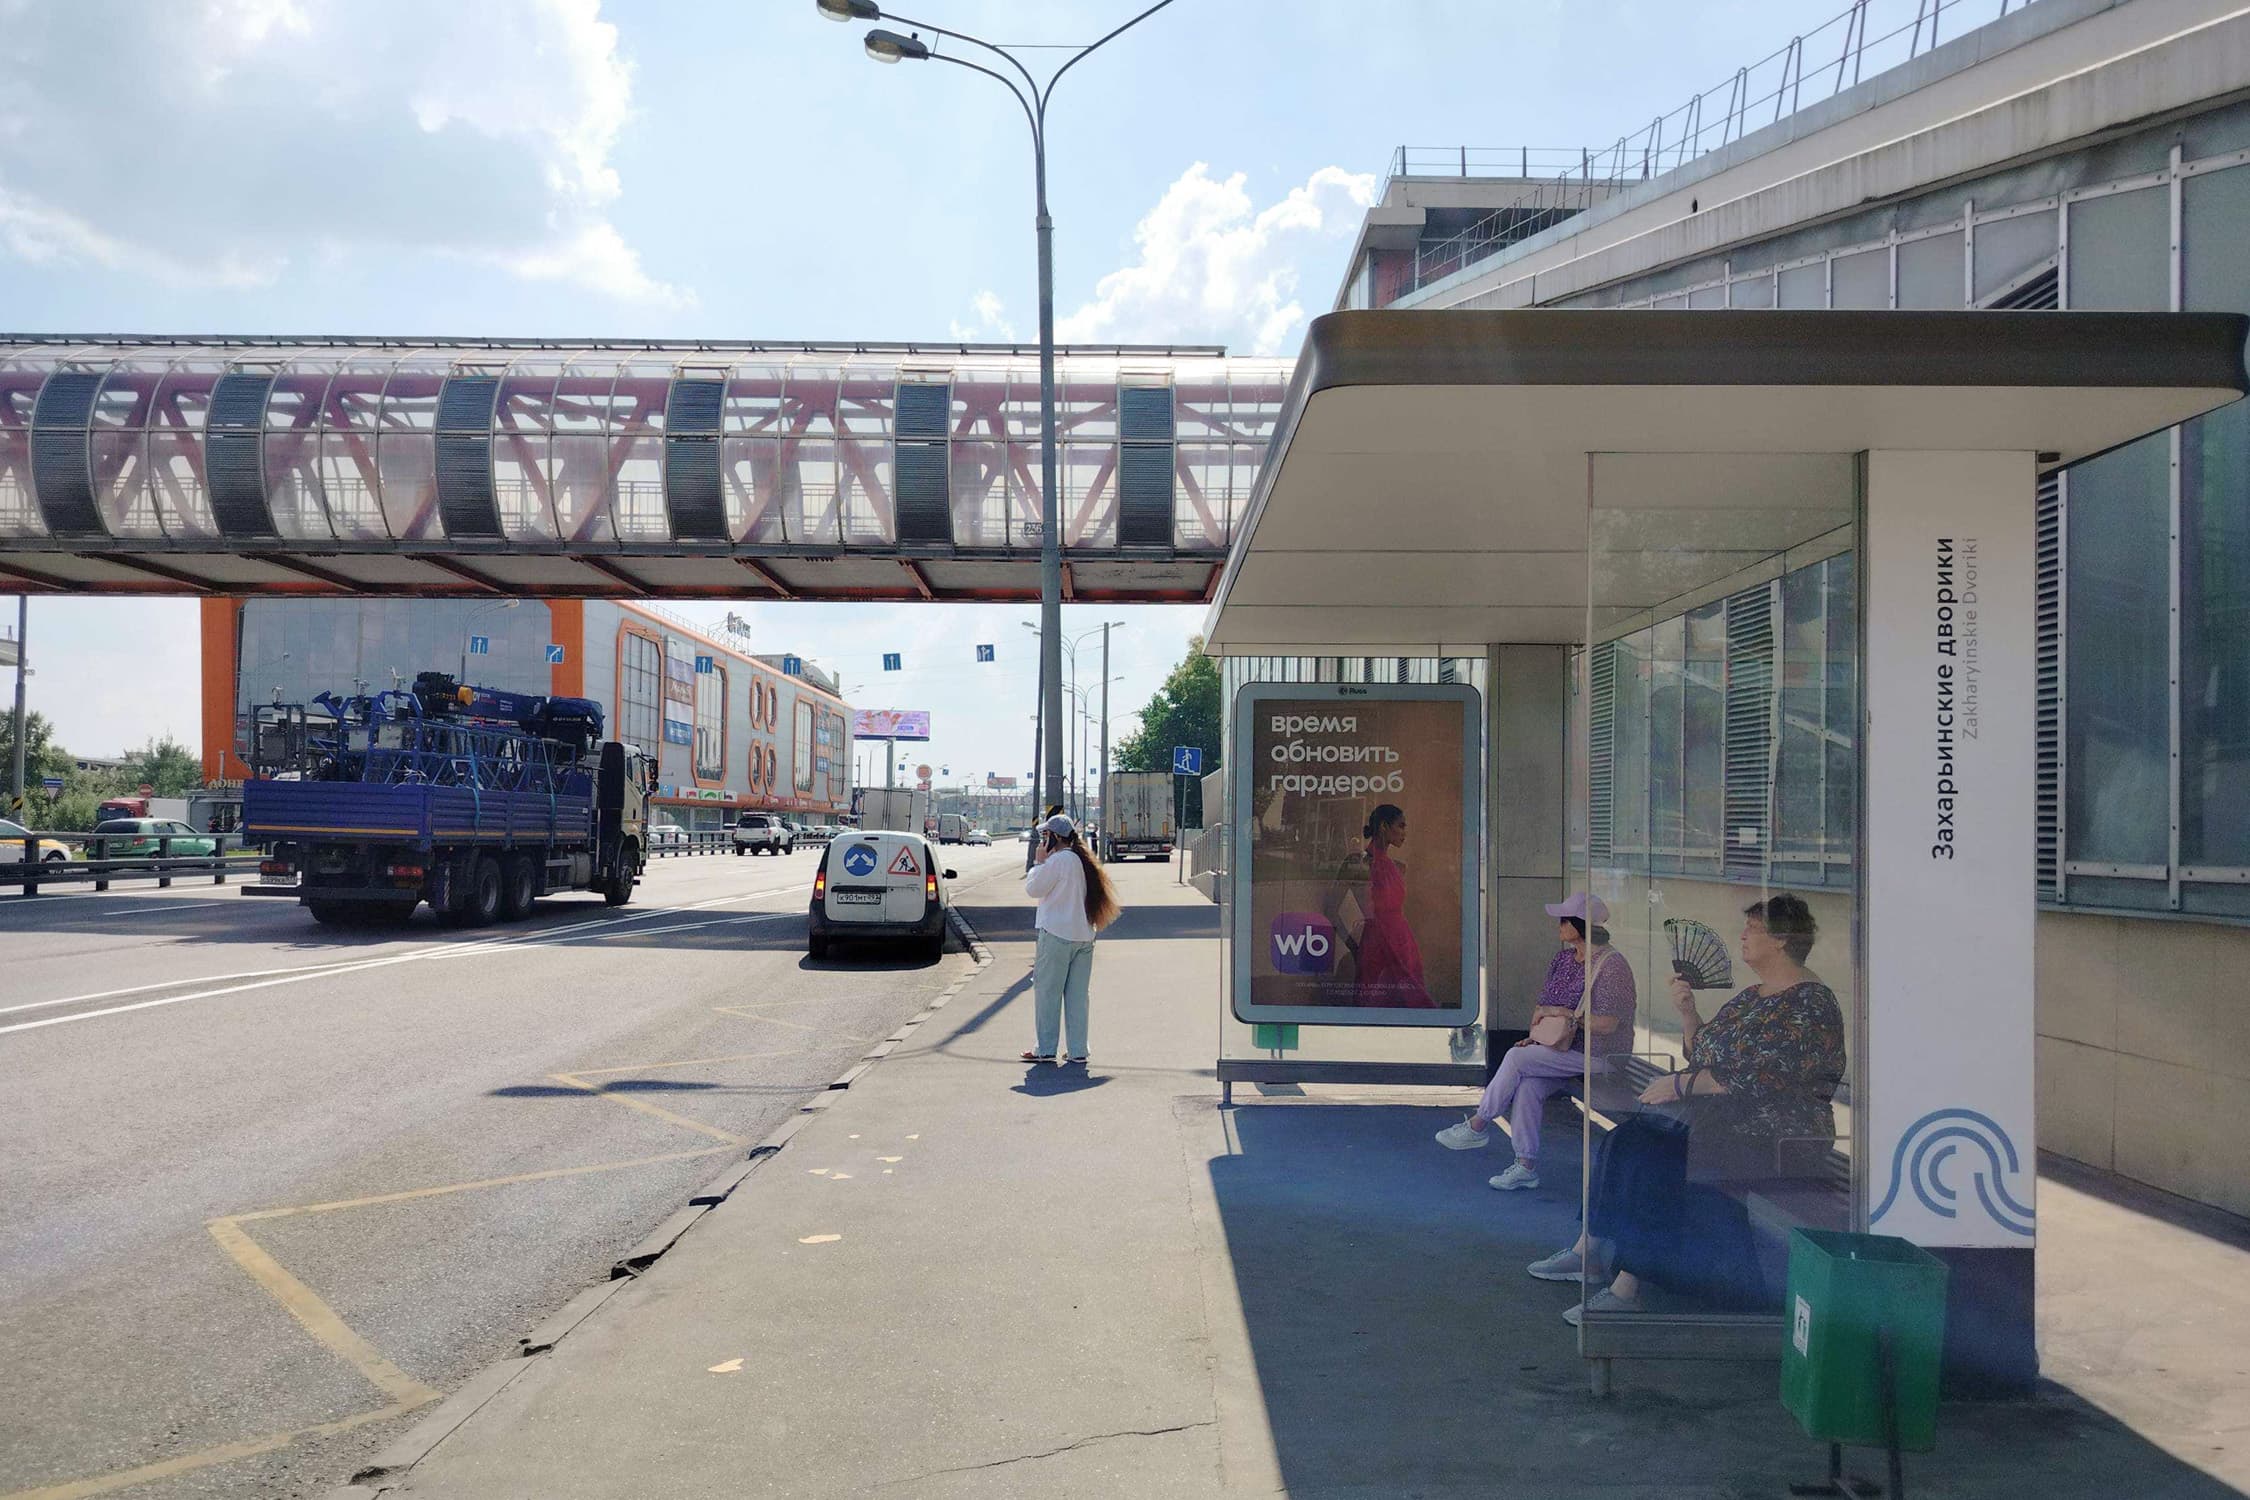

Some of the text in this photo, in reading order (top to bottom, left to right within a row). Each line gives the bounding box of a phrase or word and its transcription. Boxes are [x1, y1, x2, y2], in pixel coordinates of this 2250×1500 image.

[1962, 538, 1981, 740] Zakharyinskie Dvoriki
[1931, 538, 1958, 860] Захарьинские дворики
[1271, 716, 1357, 737] время
[1271, 739, 1400, 762] обновить
[1271, 770, 1405, 797] гардероб
[1274, 926, 1329, 957] wb
